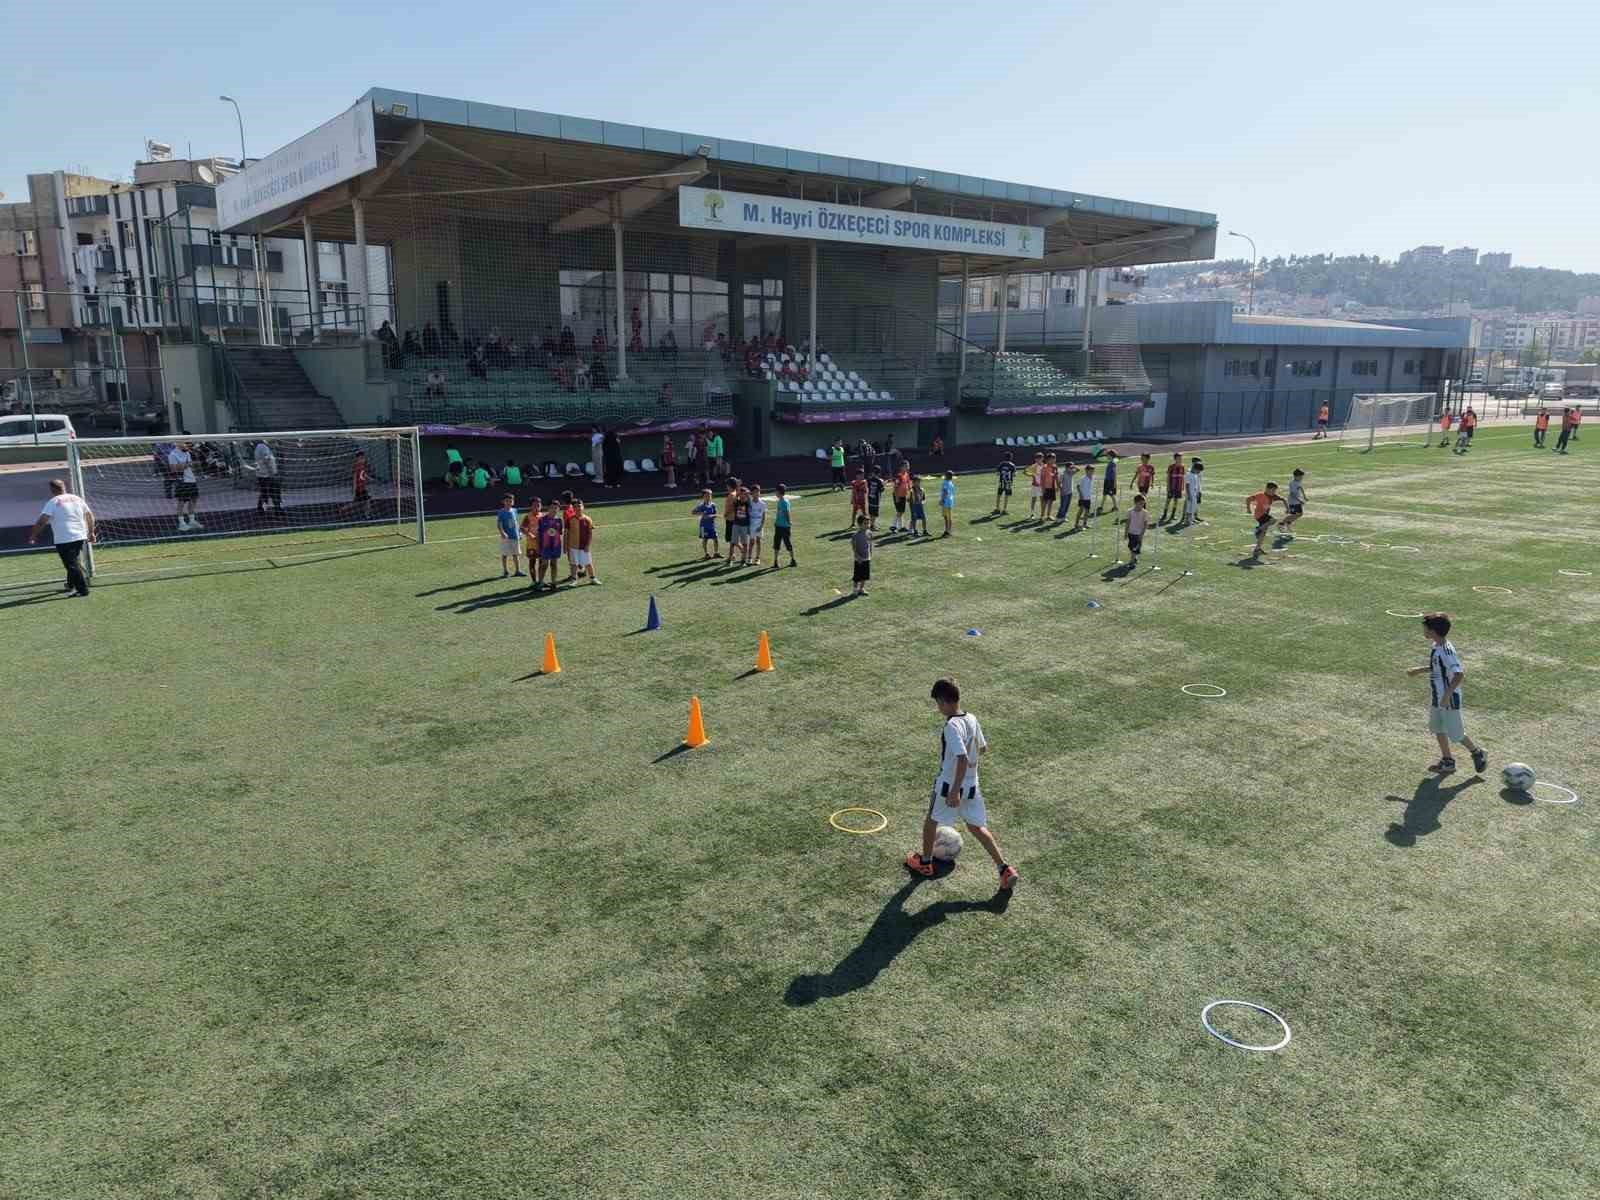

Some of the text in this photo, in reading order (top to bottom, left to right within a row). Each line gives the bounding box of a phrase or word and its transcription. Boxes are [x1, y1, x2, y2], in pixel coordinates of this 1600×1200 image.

[743, 202, 1006, 247] M. Hayri ÖZKEÇECİ SPOR KOMPLEKSİ
